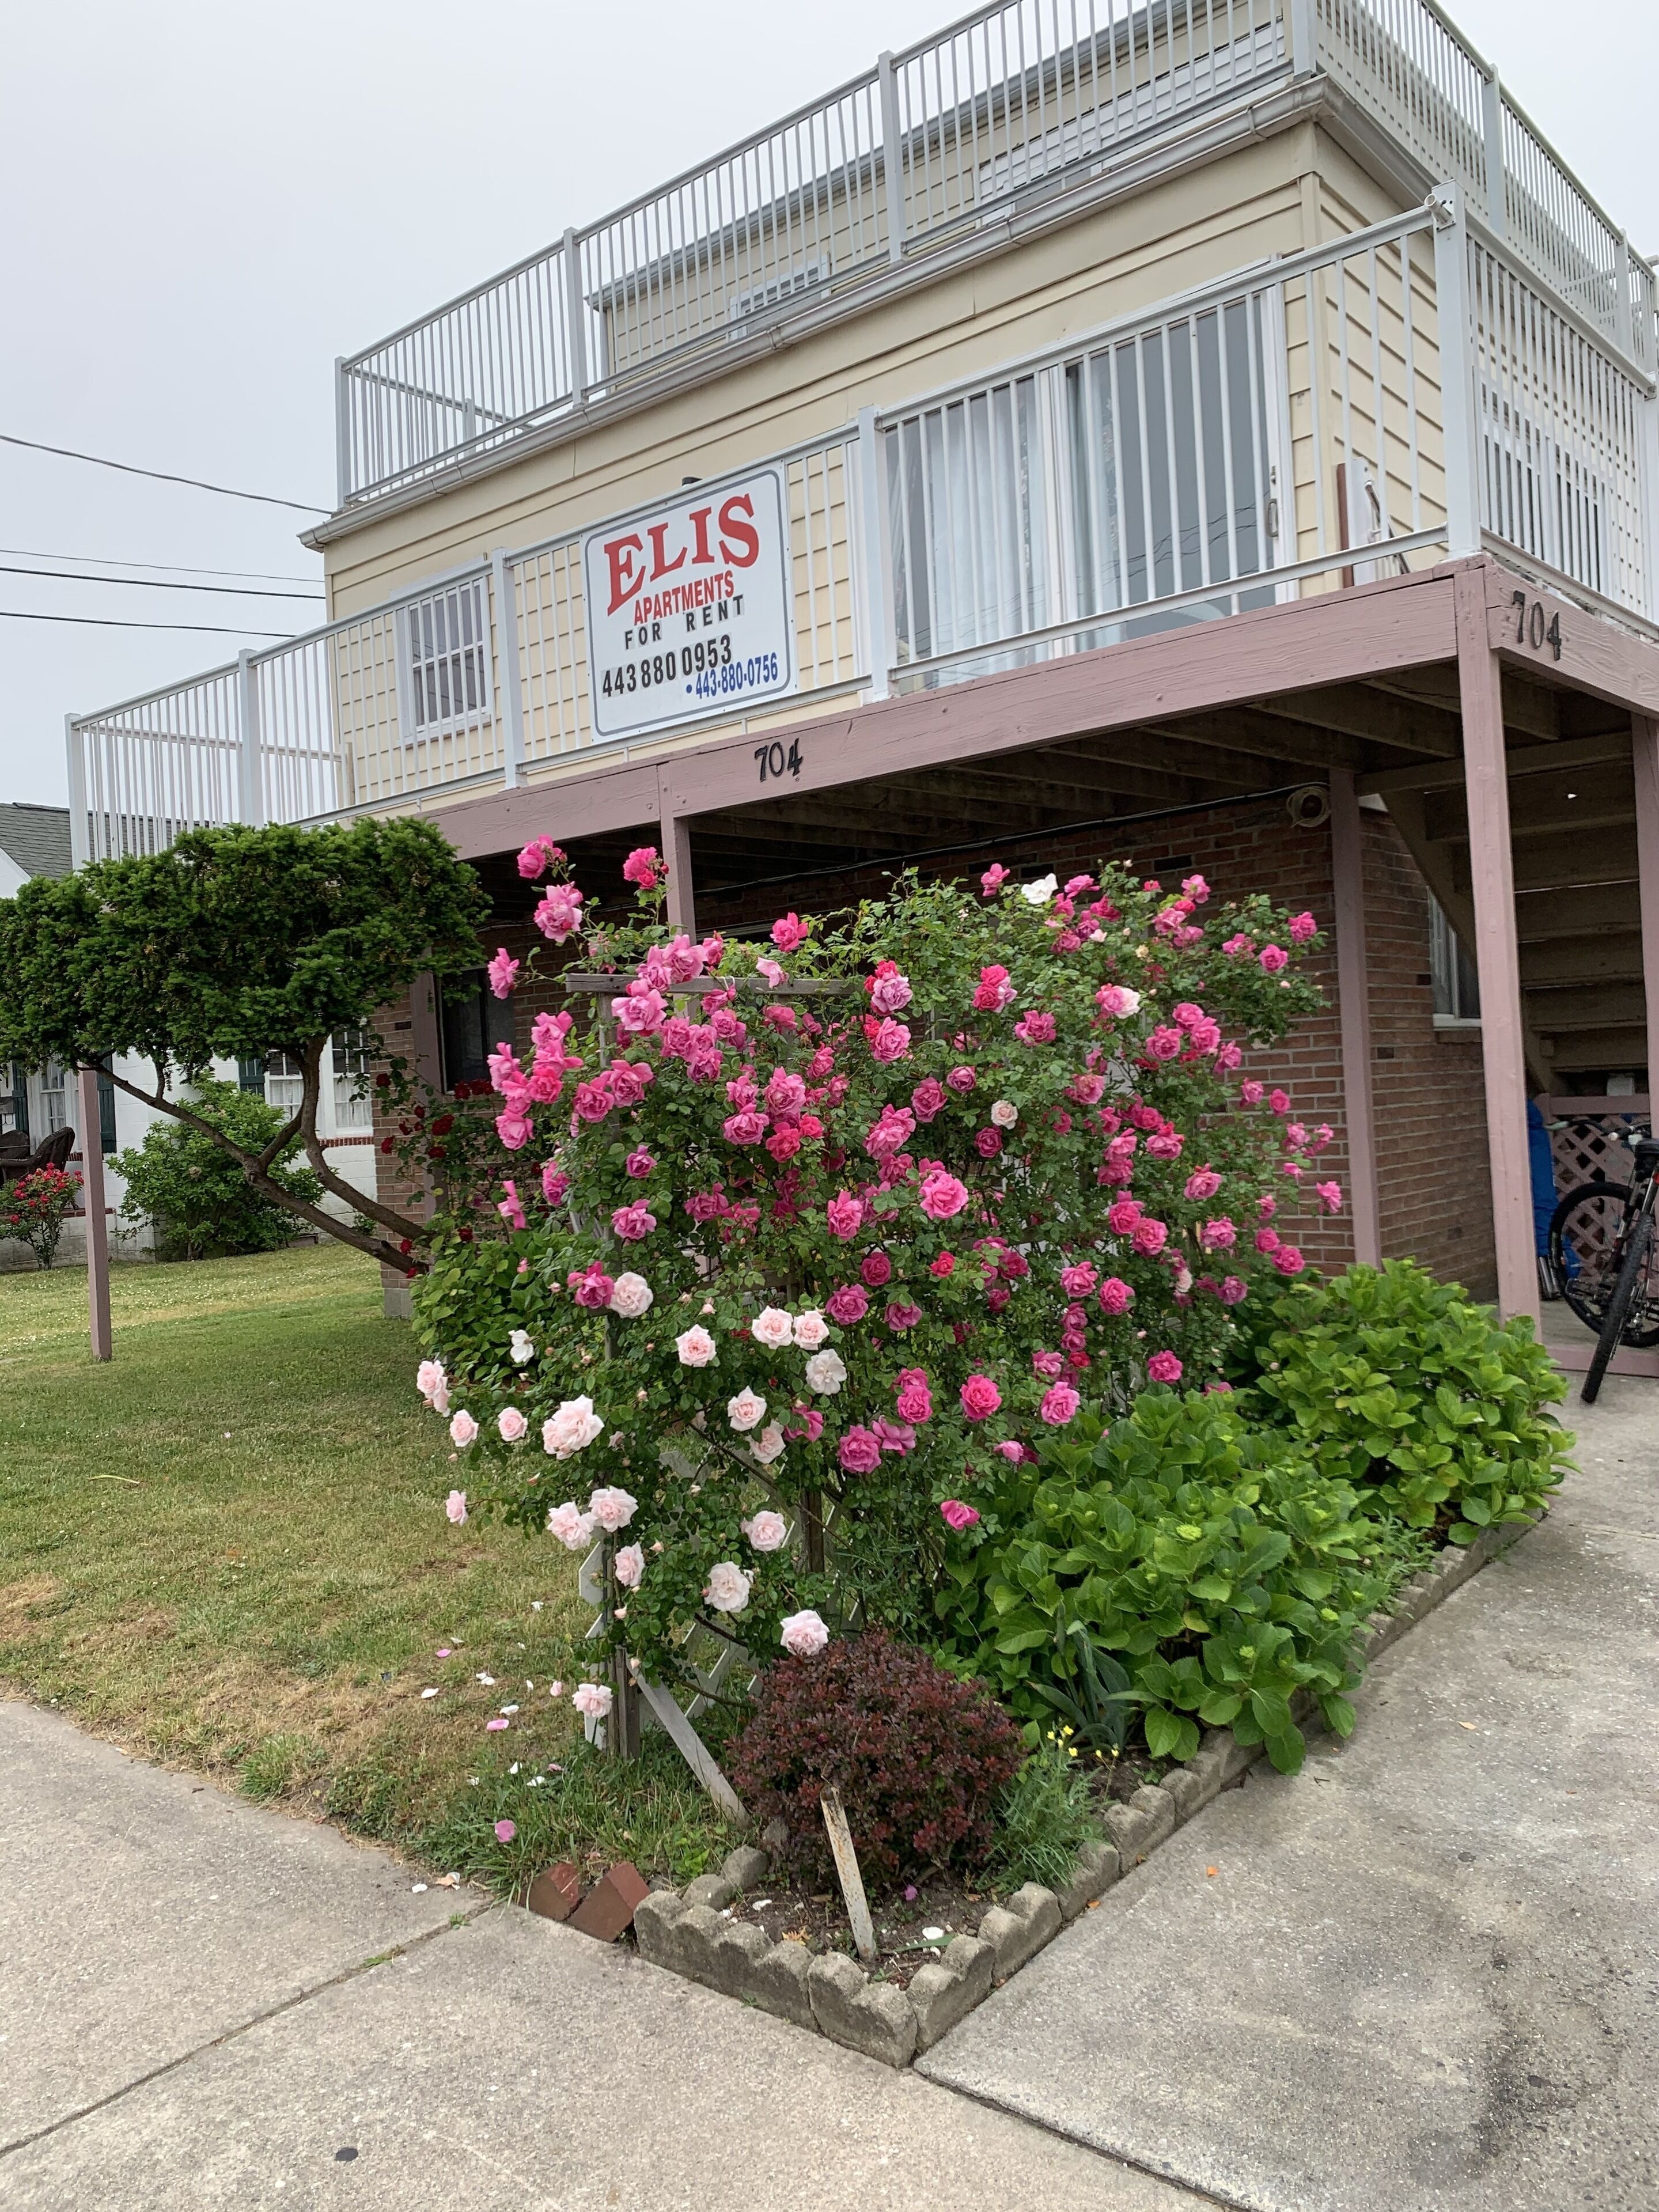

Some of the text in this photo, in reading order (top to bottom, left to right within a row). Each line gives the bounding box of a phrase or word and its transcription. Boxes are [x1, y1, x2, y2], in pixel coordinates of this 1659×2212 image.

[604, 493, 759, 617] ELIS
[625, 594, 743, 650] FOR RENT
[634, 570, 734, 626] APARTMENTS
[1512, 590, 1562, 661] 704
[755, 737, 803, 782] 704
